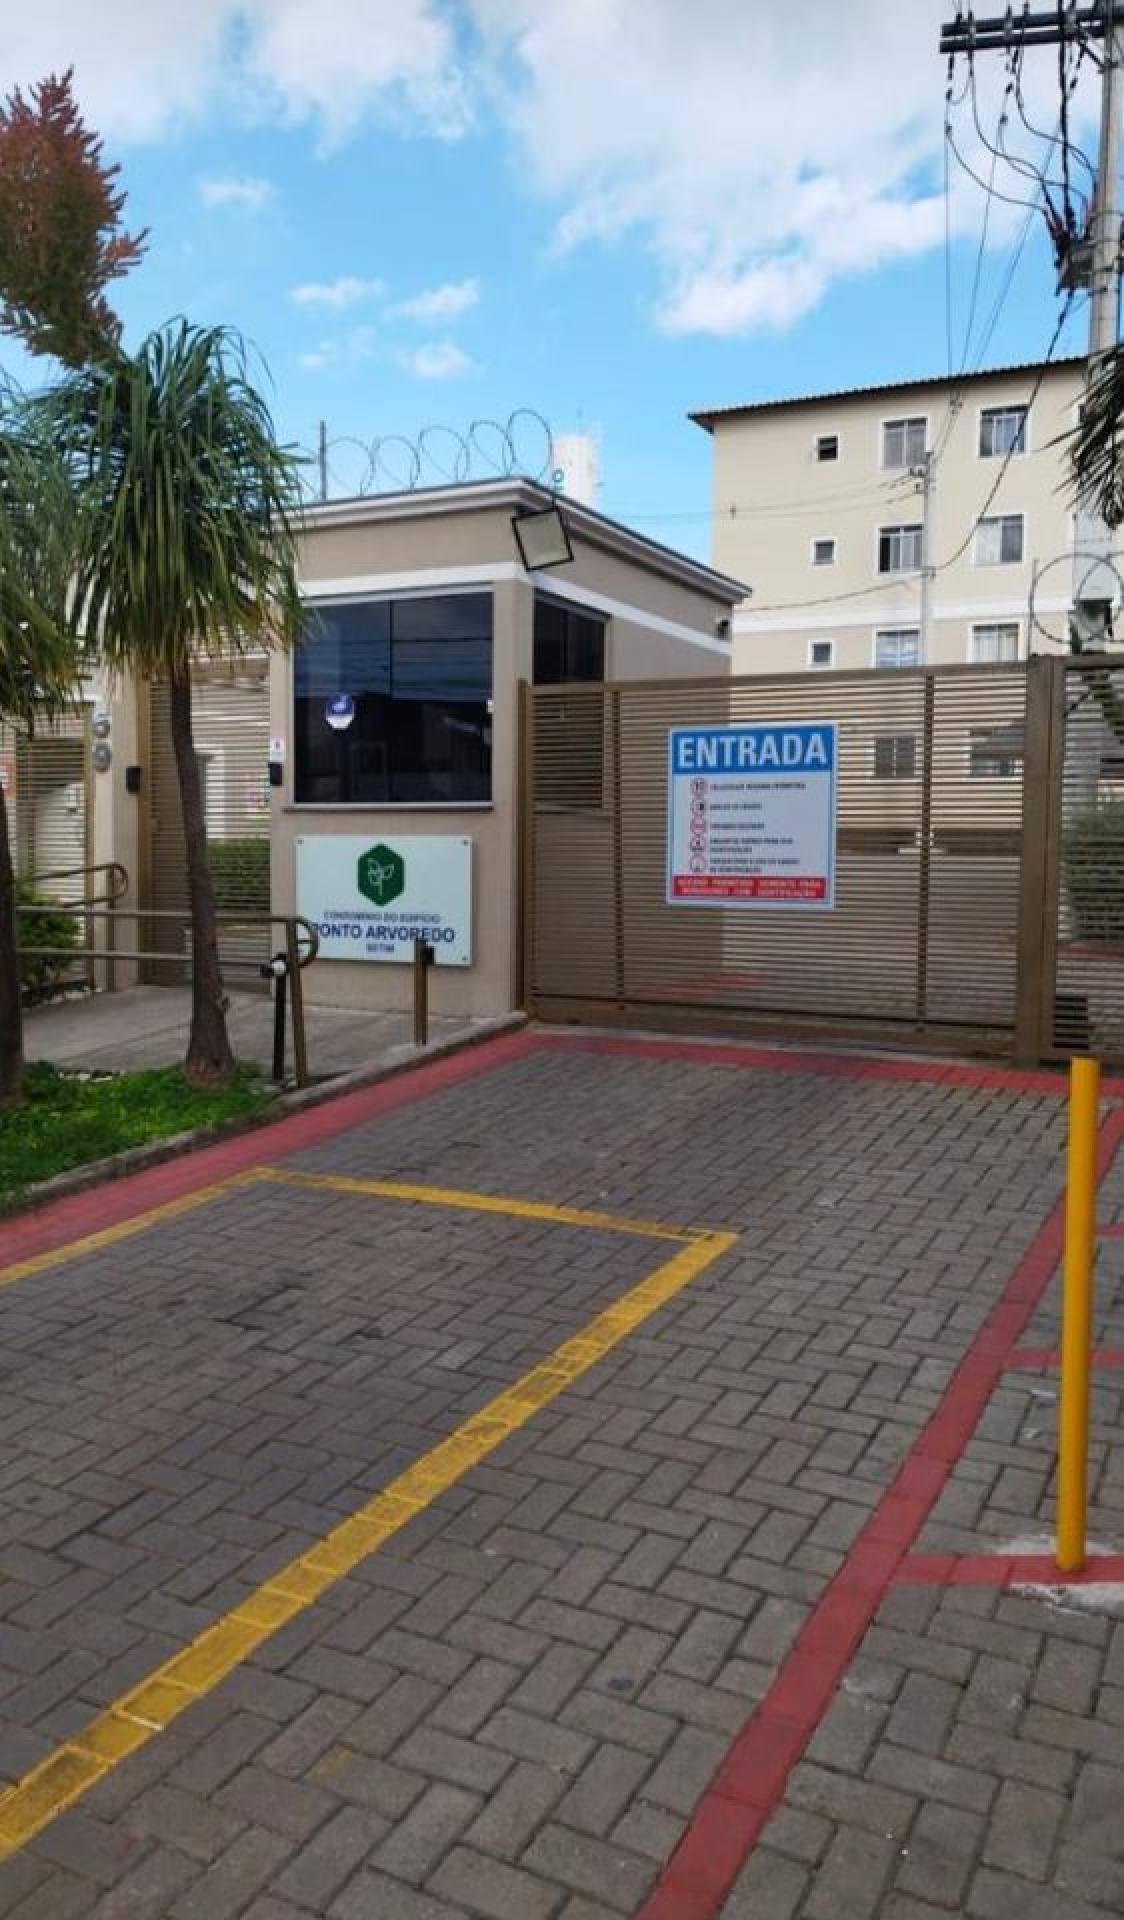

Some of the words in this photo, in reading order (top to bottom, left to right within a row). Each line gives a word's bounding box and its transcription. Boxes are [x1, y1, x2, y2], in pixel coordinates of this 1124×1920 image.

[678, 733, 829, 769] ENTRADA
[385, 912, 398, 922] DO
[366, 925, 455, 943] ARVOREDO
